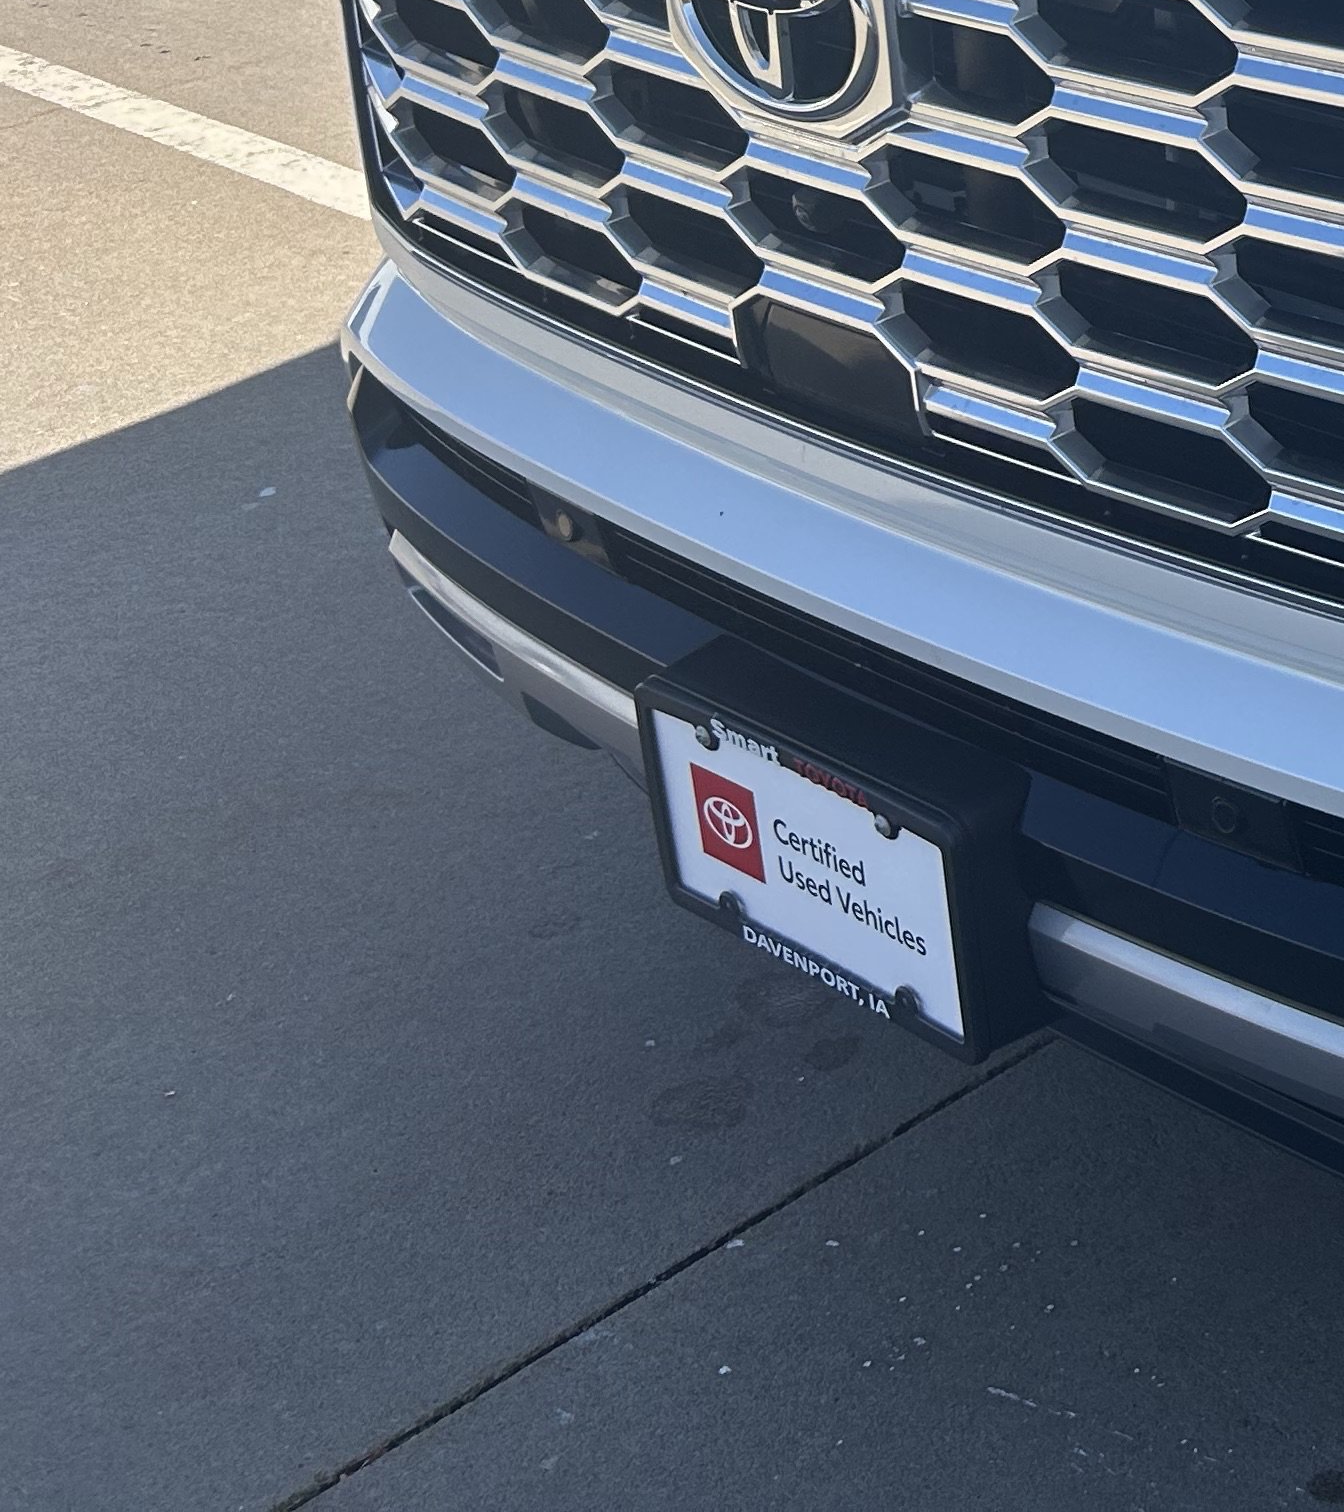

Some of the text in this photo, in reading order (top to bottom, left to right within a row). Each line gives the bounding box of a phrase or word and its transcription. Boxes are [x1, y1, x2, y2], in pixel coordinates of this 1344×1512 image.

[710, 718, 868, 808] Smart TOYOTA
[773, 818, 866, 887] Certified
[778, 855, 927, 956] Used Vehicles
[742, 925, 891, 1019] DAVENPORT, IA
